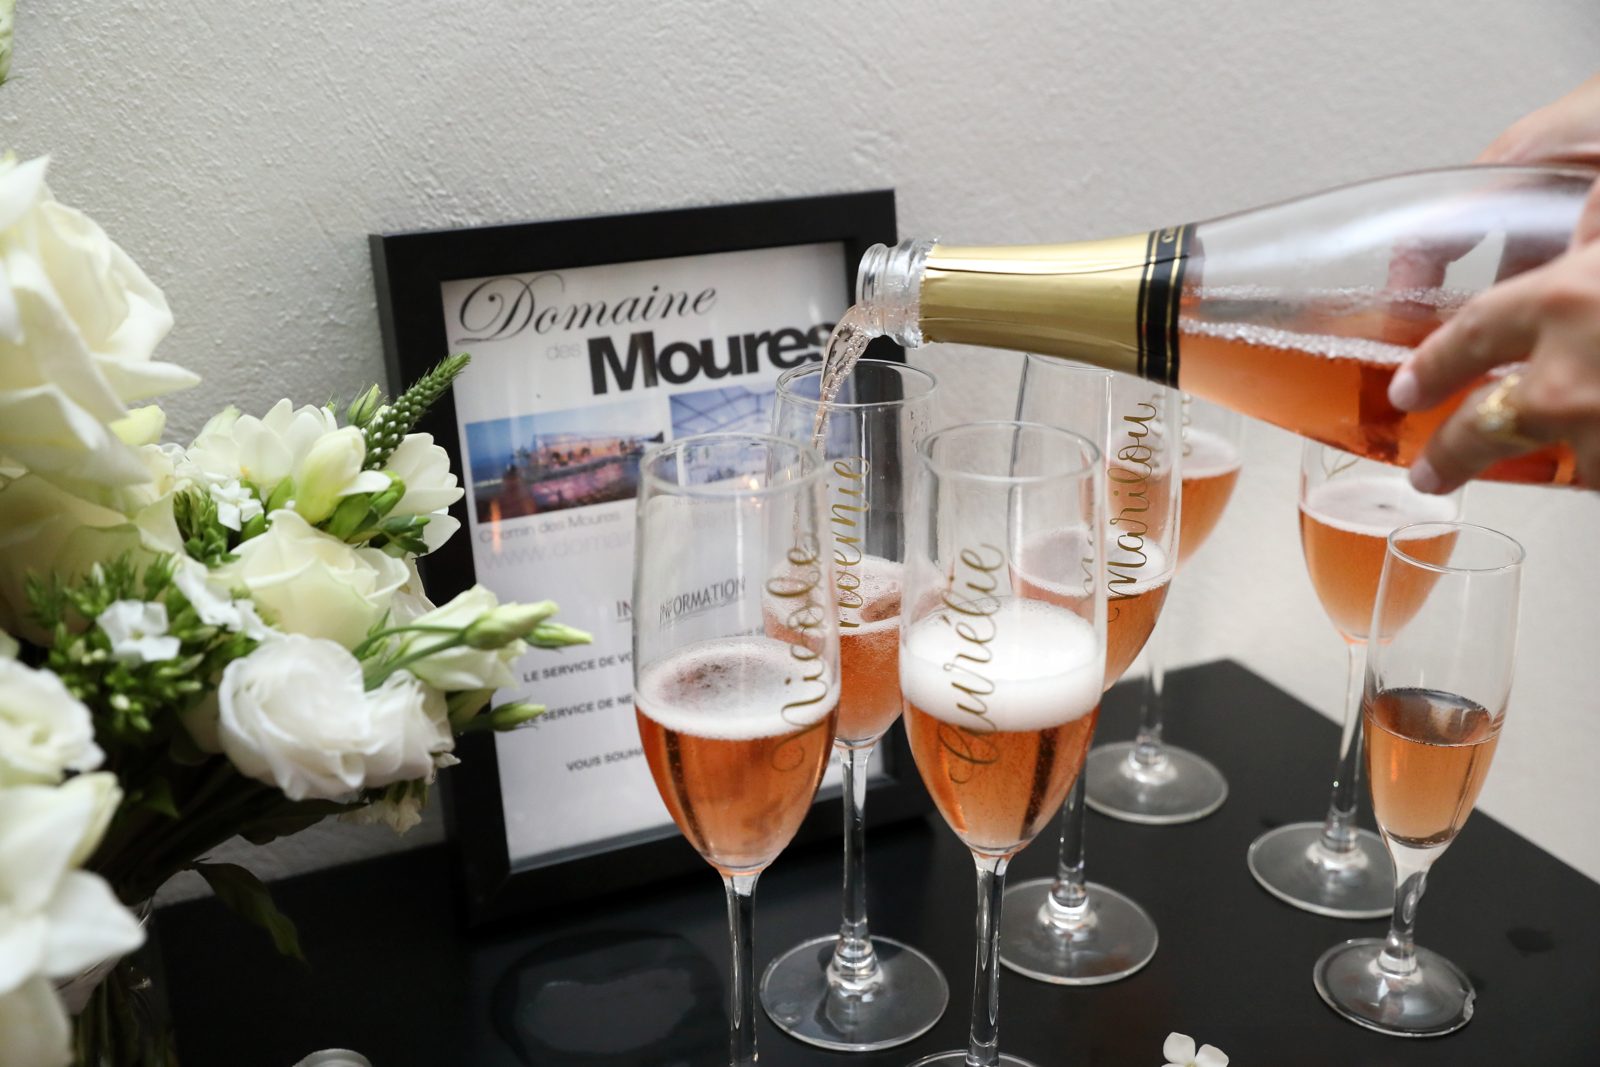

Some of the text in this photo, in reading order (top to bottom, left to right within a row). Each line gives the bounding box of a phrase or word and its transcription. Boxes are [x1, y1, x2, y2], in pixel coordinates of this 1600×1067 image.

[455, 274, 716, 345] Domaine
[546, 322, 837, 395] des Moures
[479, 510, 621, 544] Cemin des Moures
[523, 671, 539, 683] LE
[542, 658, 595, 679] SERVICE
[598, 653, 616, 668] DE
[767, 532, 828, 772] Nicole
[542, 702, 594, 722] SERVICE
[597, 696, 614, 711] DE
[565, 755, 602, 771] VOUS
